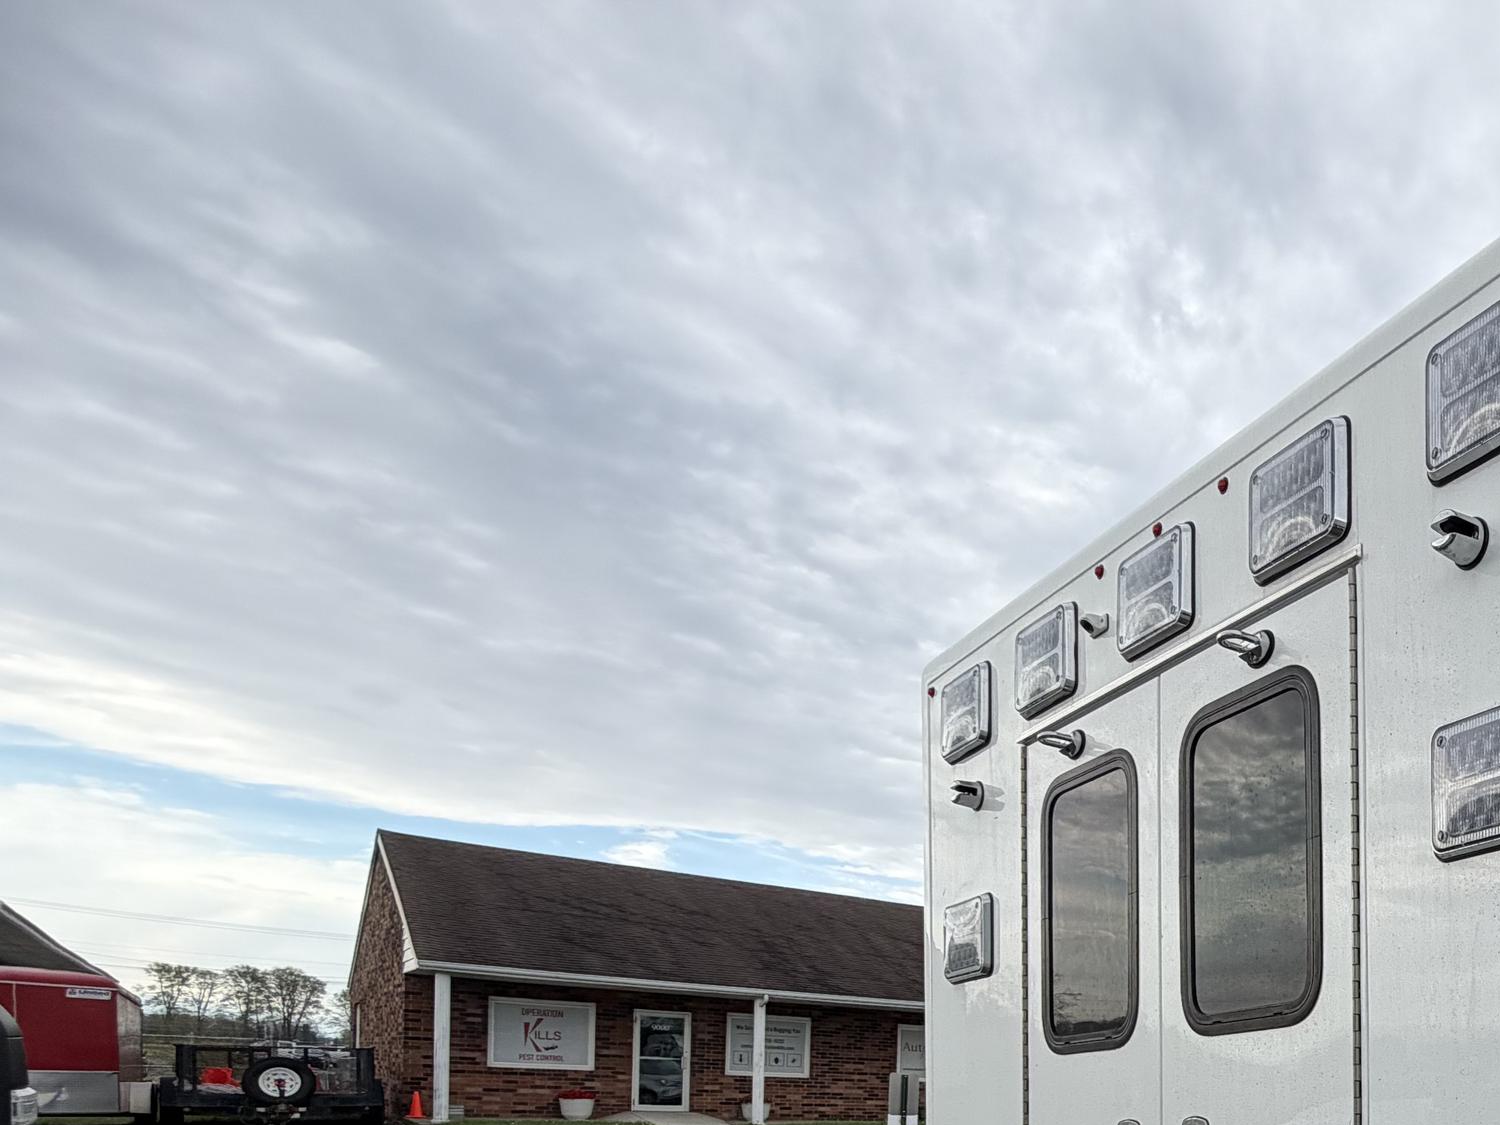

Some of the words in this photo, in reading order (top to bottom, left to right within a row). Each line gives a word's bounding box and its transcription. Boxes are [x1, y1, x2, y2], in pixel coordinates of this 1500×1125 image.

[521, 1008, 564, 1018] OPERATION
[518, 1053, 534, 1061] PEST
[536, 1054, 564, 1062] CONTROL
